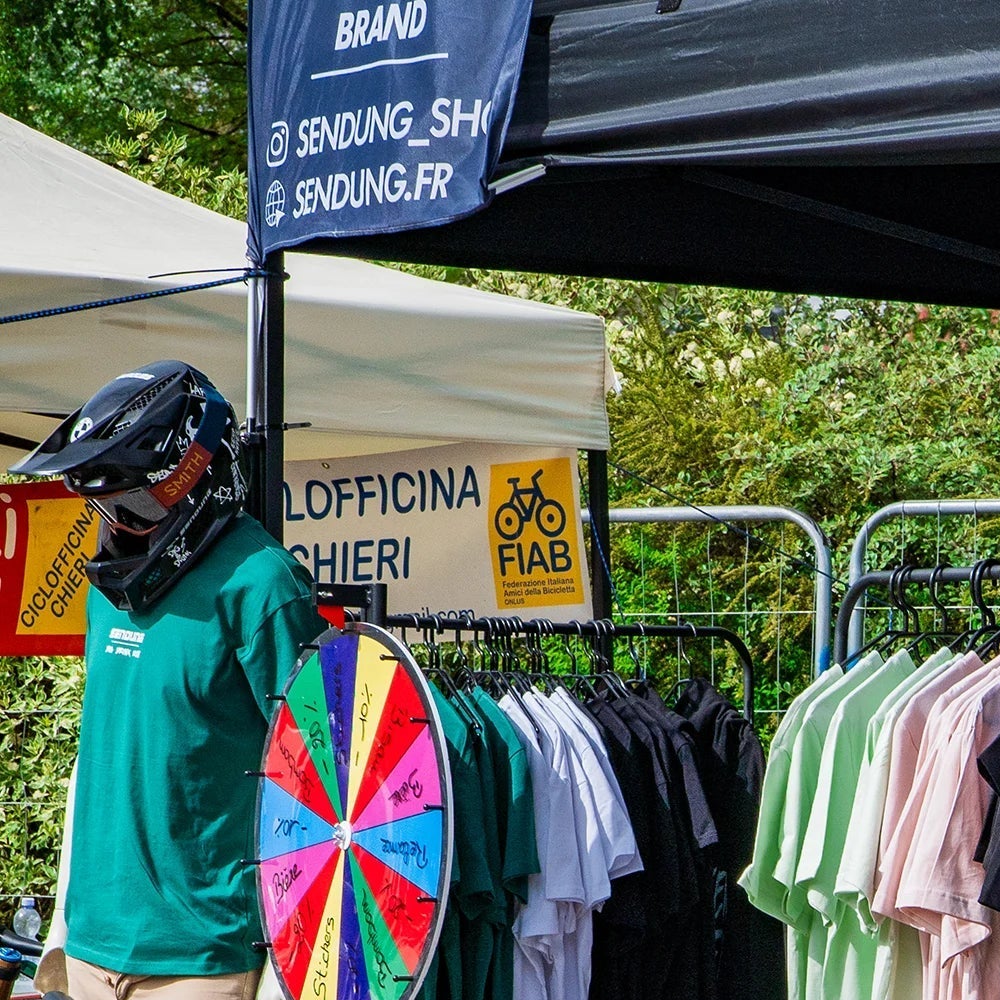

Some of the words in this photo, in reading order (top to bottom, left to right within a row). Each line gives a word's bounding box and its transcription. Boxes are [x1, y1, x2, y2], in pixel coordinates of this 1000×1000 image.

[334, 0, 427, 51] BRAND
[292, 162, 453, 219] SENDUNG.FR
[164, 452, 203, 496] SMITH
[20, 502, 95, 628] CICLOFFICINA
[498, 540, 572, 577] FIAB
[50, 551, 90, 618] CHIERI
[502, 579, 546, 589] Federazione
[547, 577, 574, 586] Italiana
[503, 588, 523, 597] Amici
[524, 588, 541, 596] della
[543, 586, 575, 595] Bicicletta
[504, 598, 525, 606] ONLUS
